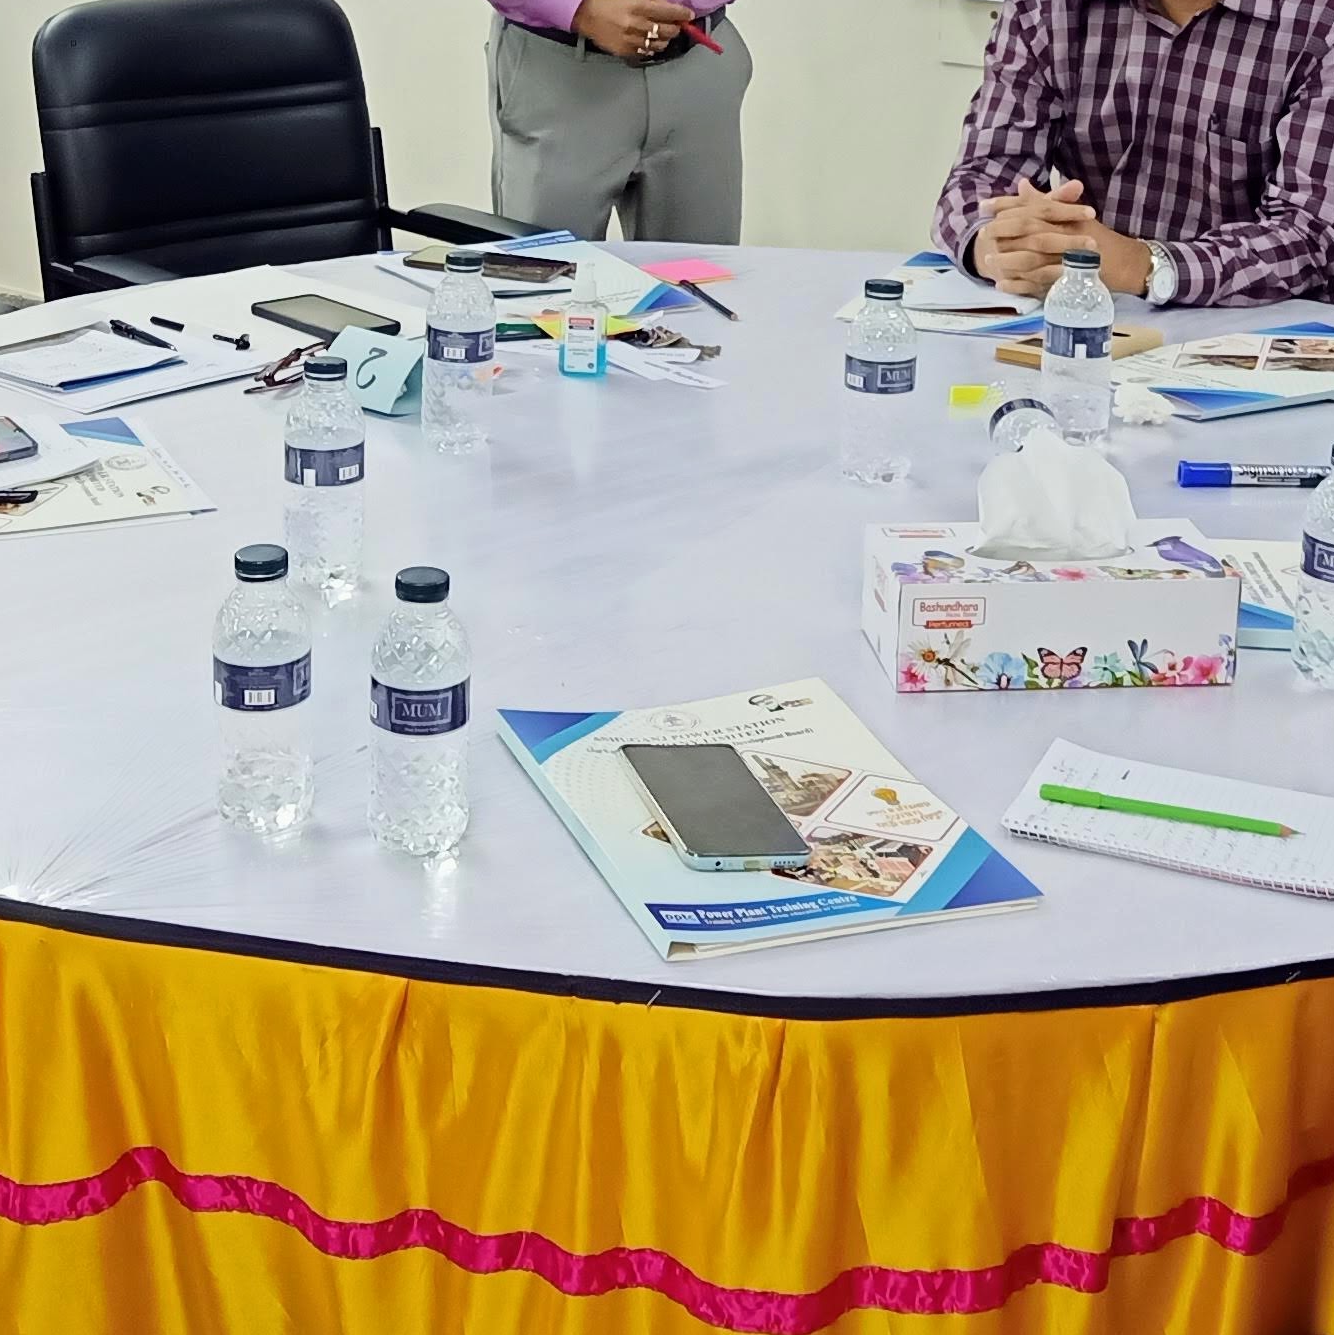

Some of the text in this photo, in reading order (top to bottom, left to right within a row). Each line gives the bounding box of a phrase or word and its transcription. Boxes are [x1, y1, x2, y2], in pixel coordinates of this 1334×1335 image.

[919, 601, 979, 613] Bashundhara
[401, 702, 442, 718] MUM
[724, 716, 786, 733] STATION
[696, 909, 735, 920] Power
[735, 907, 766, 918] Plant
[766, 901, 819, 915] Training
[817, 895, 858, 908] Centre
